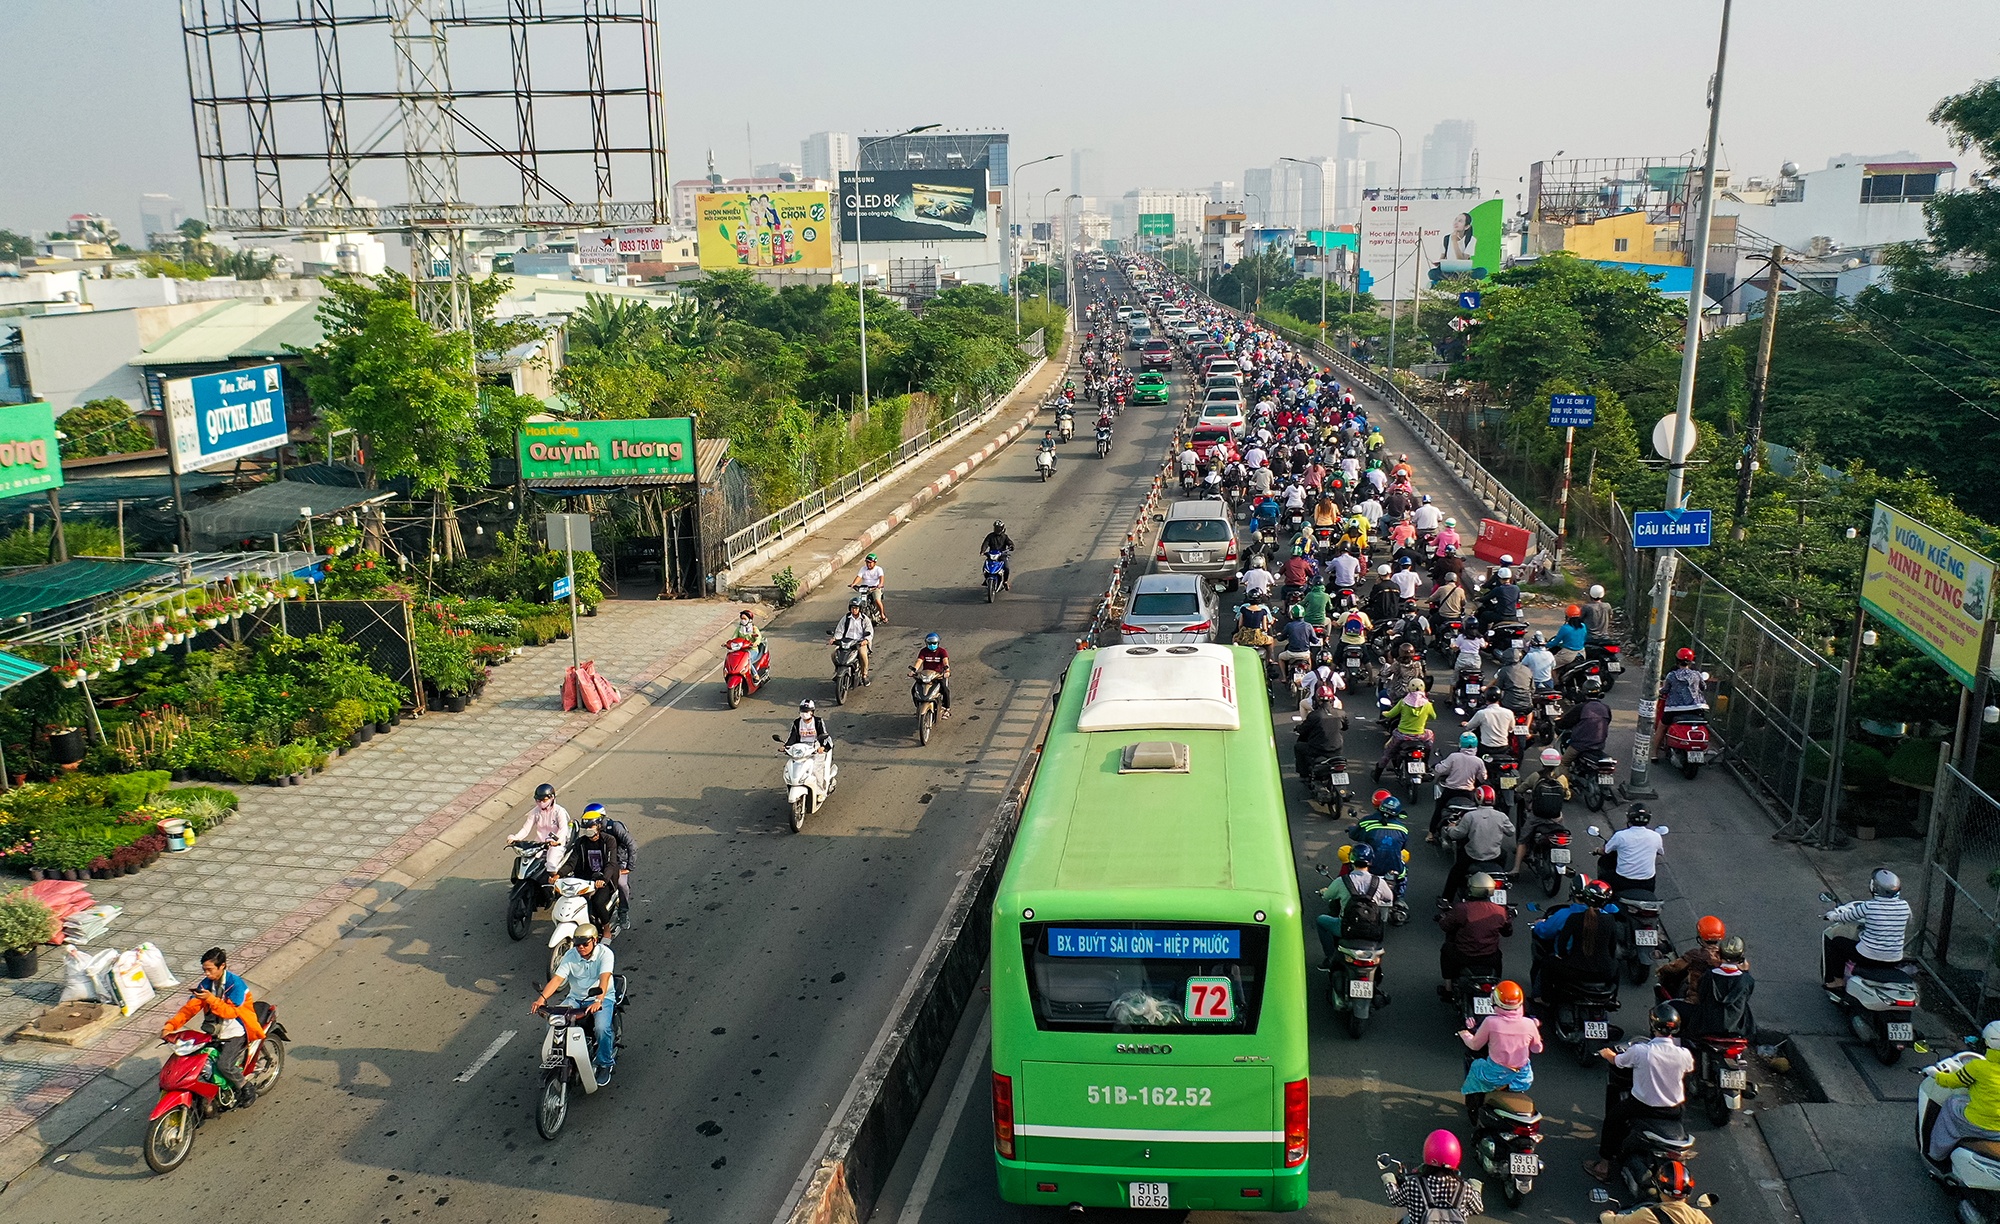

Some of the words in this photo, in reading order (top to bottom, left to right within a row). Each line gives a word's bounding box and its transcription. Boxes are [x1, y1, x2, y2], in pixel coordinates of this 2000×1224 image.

[845, 194, 881, 208] QLED
[883, 194, 900, 208] 8K
[781, 211, 806, 221] CHỌN
[619, 240, 635, 252] 0933
[637, 239, 649, 250] 751
[250, 397, 273, 427] ANH
[526, 427, 547, 437] Hoa
[529, 440, 599, 464] Quỳnh
[611, 439, 683, 461] Hương
[1637, 521, 1659, 535] CẦU
[1662, 521, 1690, 535] KÊNH
[1694, 519, 1707, 534] TẺ
[1895, 525, 1925, 556] VƯỜN
[1927, 544, 1964, 581] KIỂNG
[1887, 548, 1921, 583] MINH
[1924, 567, 1963, 609] TÙNG
[1057, 935, 1075, 952] BX.
[1078, 931, 1107, 952] BUÝT
[1110, 932, 1128, 953] SÀI
[1131, 932, 1153, 954] GÒN
[1164, 933, 1189, 956] HIỆP
[1193, 932, 1229, 954] PHƯỚC
[1191, 985, 1228, 1016] 72
[1116, 1043, 1173, 1055] SAMCO
[1088, 1085, 1212, 1106] 51B-162.52
[1138, 1183, 1160, 1195] 51B
[1132, 1195, 1168, 1207] 162.52
